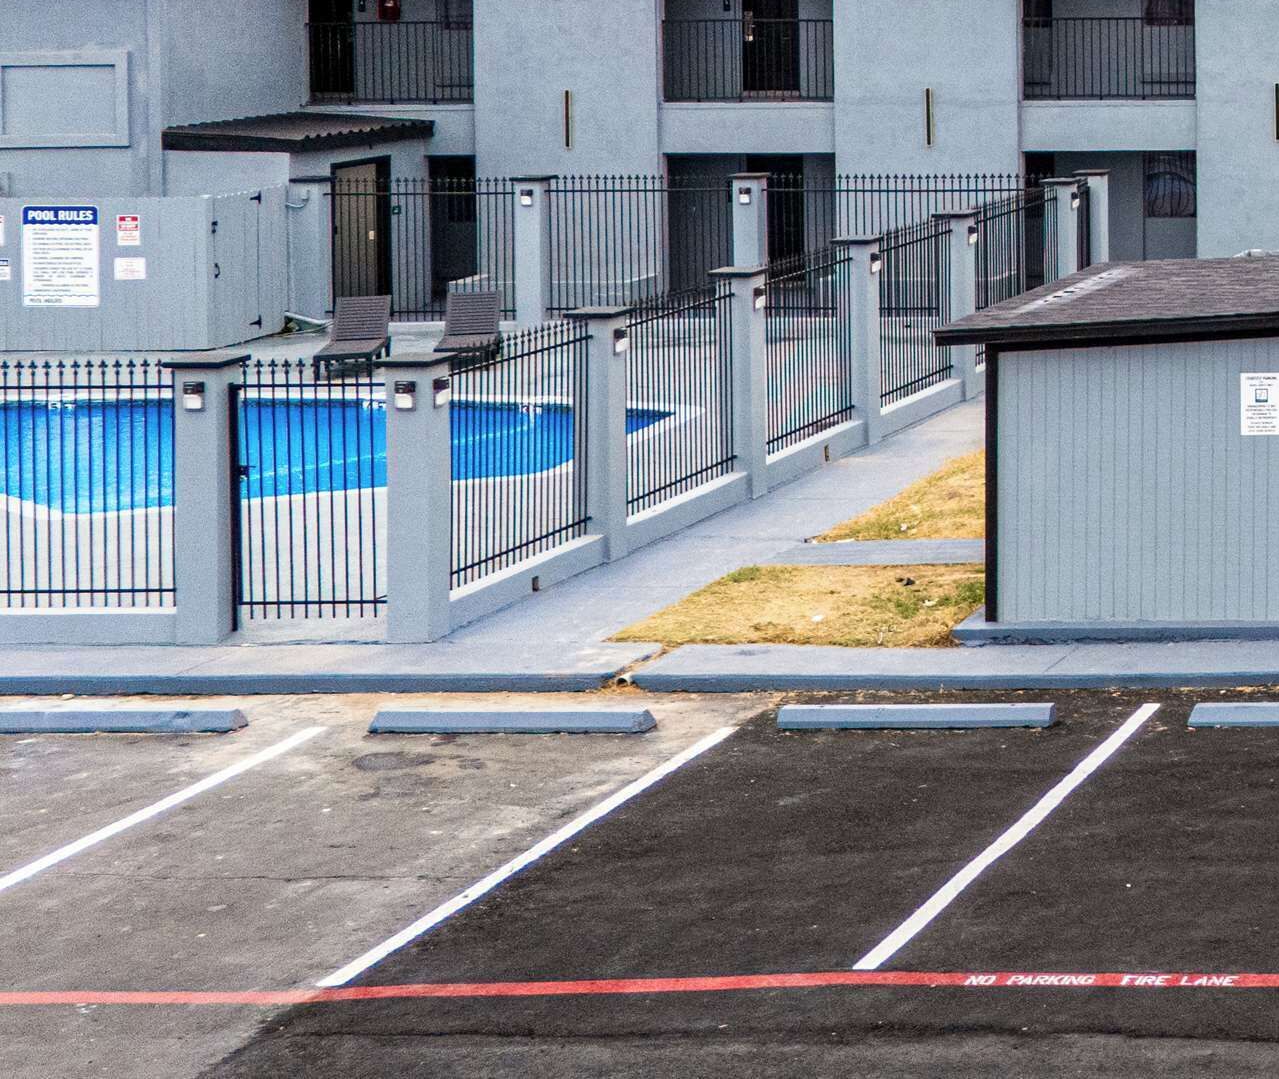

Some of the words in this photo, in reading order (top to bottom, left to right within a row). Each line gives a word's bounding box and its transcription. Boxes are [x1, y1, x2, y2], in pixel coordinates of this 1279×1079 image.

[27, 210, 57, 221] POOL
[58, 210, 94, 221] RULES
[964, 975, 996, 986] NO
[1005, 975, 1096, 986] PARKING
[1120, 975, 1172, 986] FIRE
[1179, 975, 1240, 987] LANE
